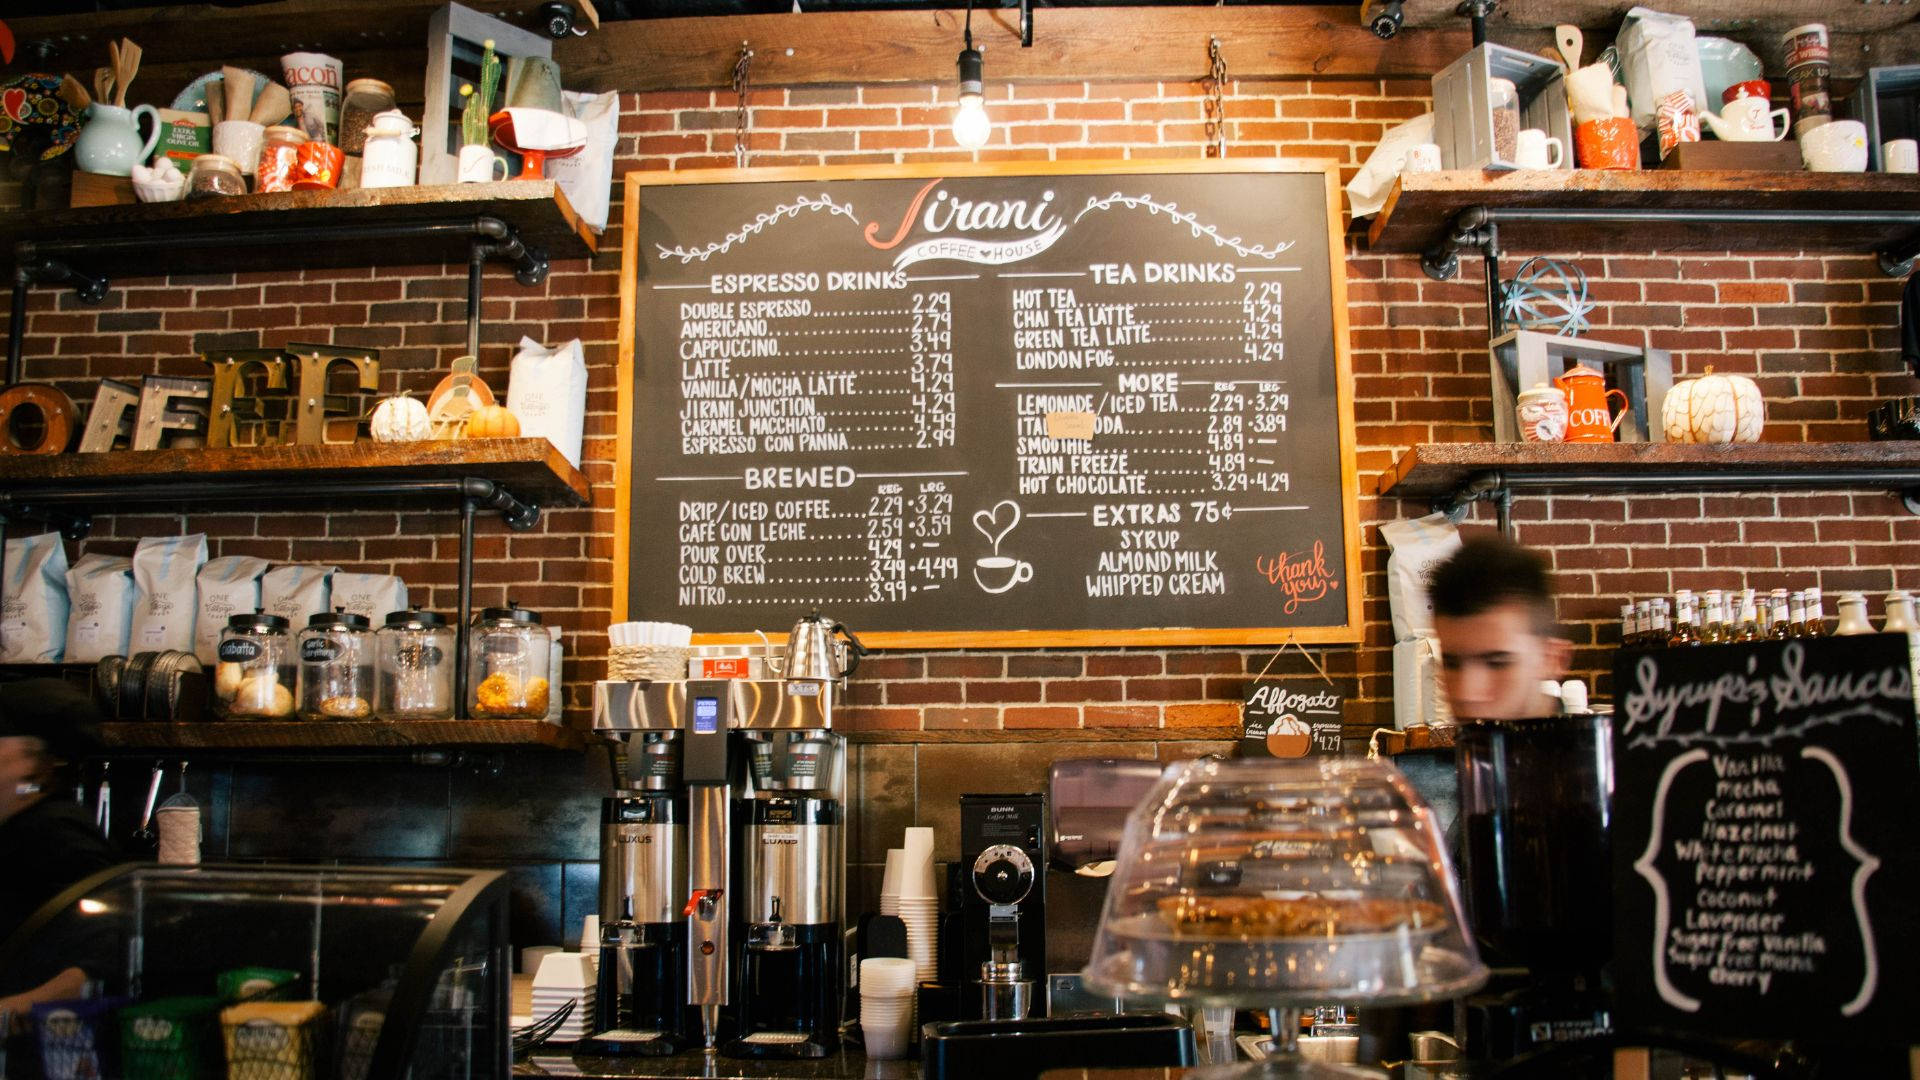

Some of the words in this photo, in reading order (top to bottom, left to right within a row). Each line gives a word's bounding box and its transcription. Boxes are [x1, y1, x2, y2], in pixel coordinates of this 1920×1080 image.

[864, 178, 1063, 250] Jirani
[917, 242, 977, 258] COFFEE
[994, 241, 1043, 260] HOUSE
[711, 273, 819, 294] ESPRESSO
[827, 271, 909, 292] DRINKS
[1090, 263, 1137, 285] TEA
[1144, 262, 1236, 283] DRINKS
[680, 302, 735, 321] DOUBLE
[739, 299, 811, 318] ESPRESSO
[911, 292, 951, 313] 2.29
[1013, 289, 1043, 309] HOT
[1047, 288, 1077, 309] TEA
[1243, 282, 1282, 305] 2.29
[680, 319, 768, 339] AMERICANO
[911, 313, 952, 333] 2.79
[1013, 310, 1049, 329] CHAI
[1054, 307, 1085, 327] TEA
[1088, 305, 1135, 326] LATTE
[1242, 304, 1282, 322] 4.29
[680, 339, 779, 360] CAPPUCCINO
[910, 332, 951, 352] 3.49
[1014, 329, 1064, 349] GREEN
[1071, 327, 1100, 347] TEA
[1106, 324, 1151, 346] LATTE
[1244, 322, 1283, 341] 4.29
[682, 359, 731, 380] LATTE
[911, 353, 953, 374] 3.79
[1016, 350, 1082, 370] LONDON
[1085, 348, 1115, 369] FOG
[1244, 343, 1284, 362] 4.29
[808, 374, 857, 396] LATTE
[911, 372, 953, 393] 4.29
[1119, 372, 1179, 393] MORE
[1214, 382, 1237, 392] REG
[1259, 382, 1281, 392] LRG
[680, 400, 735, 420] JIRANI
[738, 397, 816, 419] JUNCTION
[911, 395, 956, 414] 4.29
[1150, 393, 1179, 413] TEA
[1208, 395, 1244, 413] 2.29
[1256, 394, 1290, 412] 3.29
[681, 417, 744, 437] CARAMEL
[749, 415, 826, 435] MACCHIATO
[914, 413, 956, 432] 4.49
[1017, 416, 1048, 436] ITAL
[1095, 414, 1124, 435] ODA
[1207, 416, 1244, 435] 2.89
[1254, 414, 1287, 432] 3.89
[682, 435, 756, 455] ESPRESSO
[764, 434, 794, 452] CON
[800, 432, 849, 451] PANNA
[916, 429, 955, 449] 2.99
[1208, 434, 1244, 452] 4.89
[1017, 456, 1065, 475] TRAIN
[1071, 453, 1129, 475] FREEZE
[1208, 453, 1246, 472] 4.89
[745, 465, 856, 489] BREWED
[877, 485, 903, 495] REG
[920, 482, 945, 494] LRG
[1019, 475, 1047, 495] HOT
[1056, 474, 1147, 496] CHOCOLATE
[1212, 473, 1248, 492] 3.29
[1256, 472, 1290, 492] 4.29
[679, 500, 768, 523] DRIP/ICED
[775, 499, 831, 520] COFFEE
[868, 496, 903, 517] 2.29
[915, 494, 953, 514] 3.29
[1093, 503, 1181, 527] EXTRAS
[1192, 501, 1233, 524] 75¢
[679, 520, 715, 543] CAFÉ
[720, 523, 751, 542] CON
[760, 522, 807, 542] LECHE
[867, 518, 903, 539] 2.59
[915, 516, 951, 537] 3.59
[1120, 530, 1180, 550] SYRUP
[680, 545, 720, 564] POUR
[726, 544, 767, 564] OVER
[868, 539, 903, 560] 4.29
[1099, 552, 1171, 572] ALMOND
[1175, 551, 1219, 571] MILK
[1257, 540, 1336, 583] thank
[679, 566, 717, 585] COLD
[723, 564, 766, 585] BREW
[869, 559, 906, 582] 3.49
[917, 557, 958, 579] 4.49
[679, 586, 726, 607] NITRO
[869, 581, 907, 602] 3.99
[1086, 574, 1163, 597] WHIPPED
[1169, 572, 1226, 595] CREAM
[1246, 685, 1341, 715] Affogato
[1713, 753, 1786, 778] Vanilla
[619, 833, 652, 844] LUXUS
[1702, 821, 1800, 841] Hazelnut
[1686, 908, 1785, 931] Lavender
